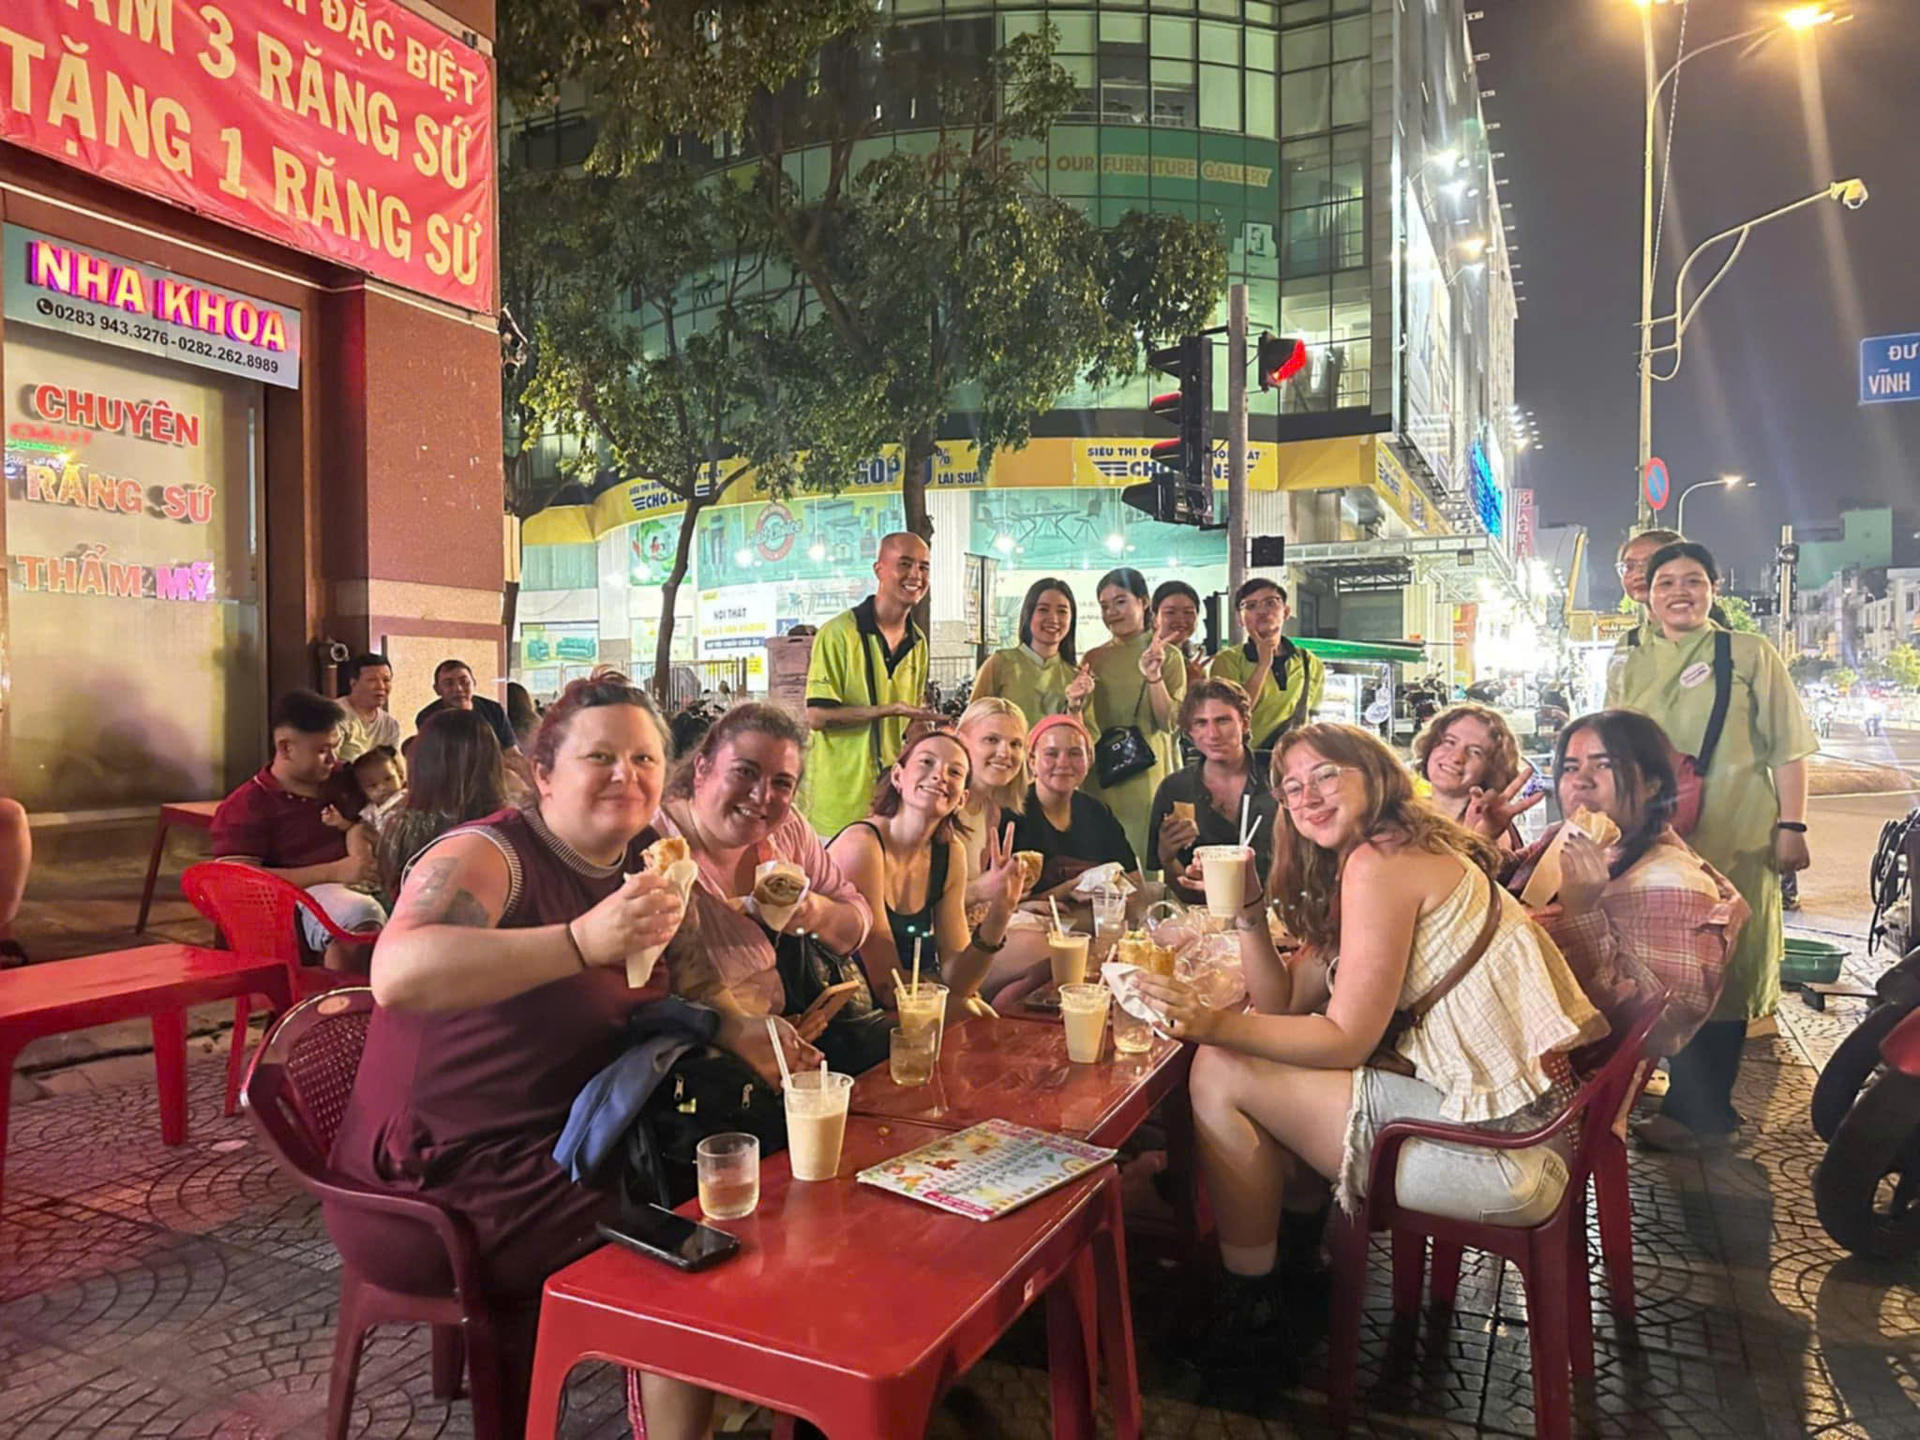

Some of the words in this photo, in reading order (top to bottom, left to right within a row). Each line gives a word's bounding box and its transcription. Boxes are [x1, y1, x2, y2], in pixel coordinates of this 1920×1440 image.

[197, 5, 236, 79] 3
[257, 31, 399, 161] RĂNG
[412, 114, 473, 190] SỨ
[406, 36, 478, 106] BIỆT
[0, 25, 193, 179] TẶNG
[219, 127, 248, 199] 1
[272, 146, 412, 263] RĂNG
[425, 212, 482, 286] SỨ
[1056, 155, 1095, 172] OUR
[1102, 155, 1196, 178] FURNITURE
[1202, 160, 1272, 187] GALLERY
[30, 240, 147, 314] NHA
[154, 276, 289, 352] KHOA
[54, 304, 95, 327] 0283
[1868, 368, 1911, 395] VĨNH
[35, 384, 200, 446] CHUYÊN
[163, 484, 215, 524] SỨ
